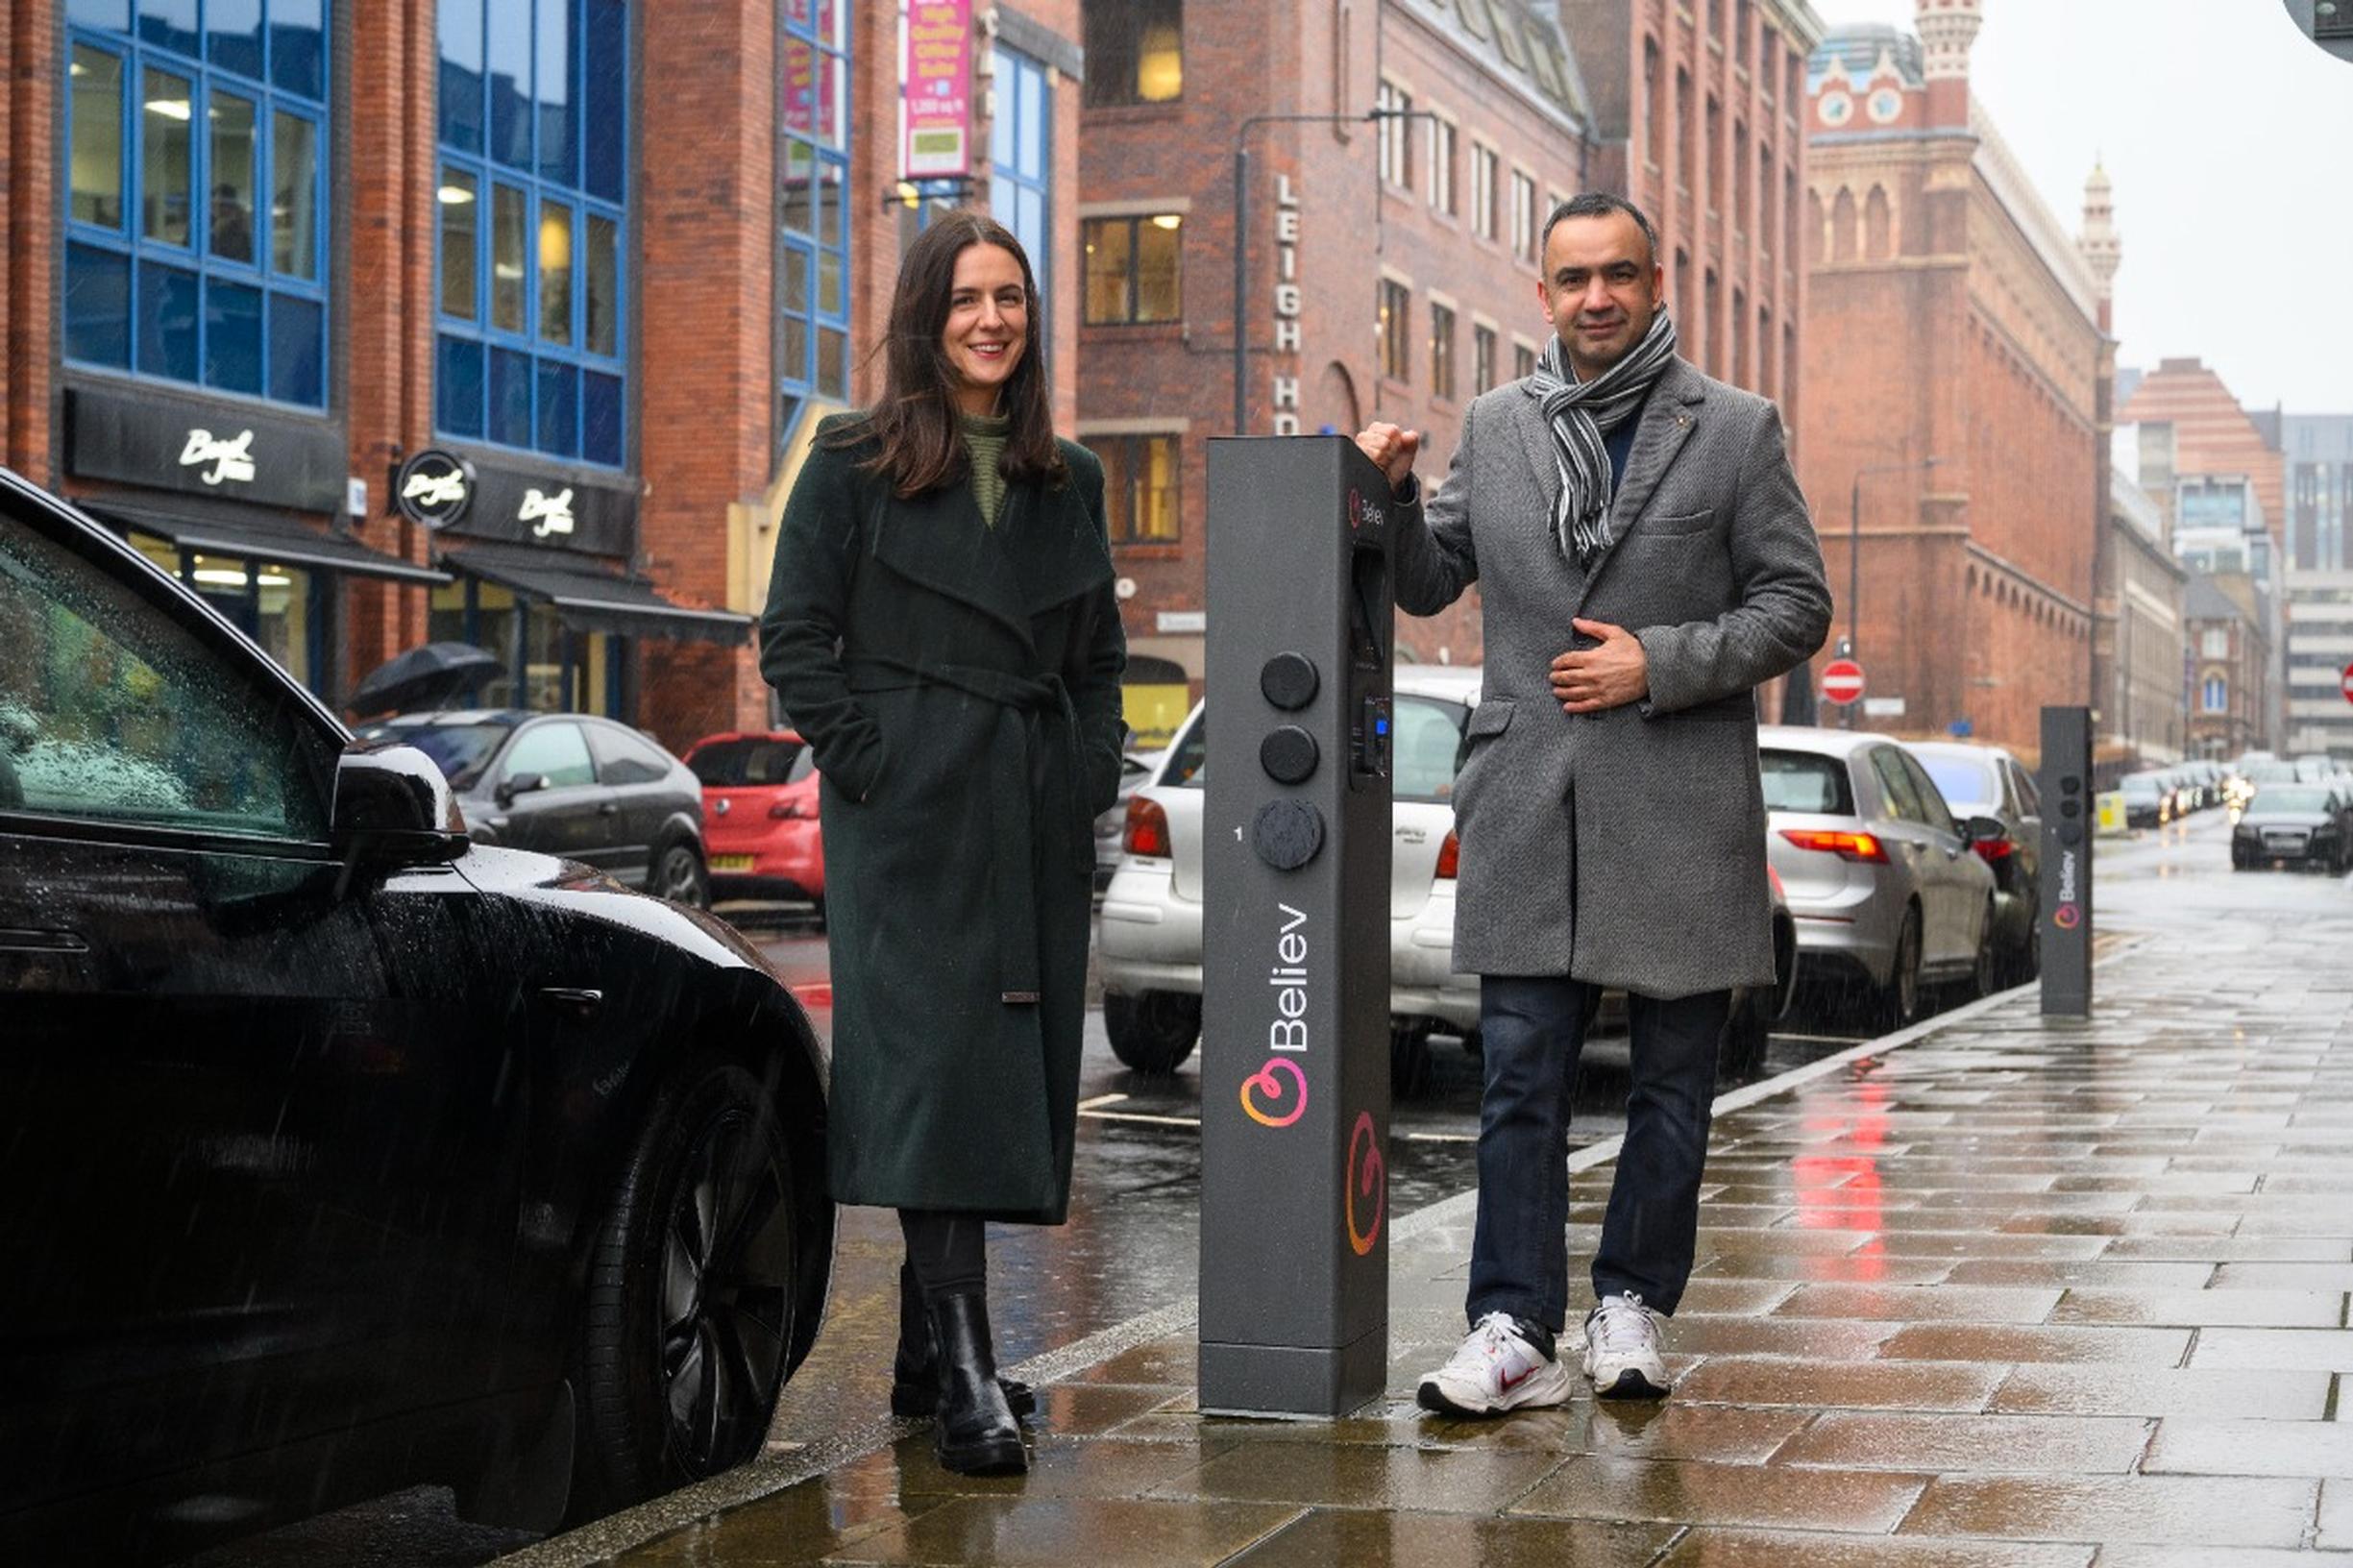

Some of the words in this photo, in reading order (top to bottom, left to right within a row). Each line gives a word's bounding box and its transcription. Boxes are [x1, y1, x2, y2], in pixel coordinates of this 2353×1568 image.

[1277, 174, 1302, 352] LEIGH
[1234, 826, 1242, 841] 1
[1269, 902, 1308, 1051] Believ
